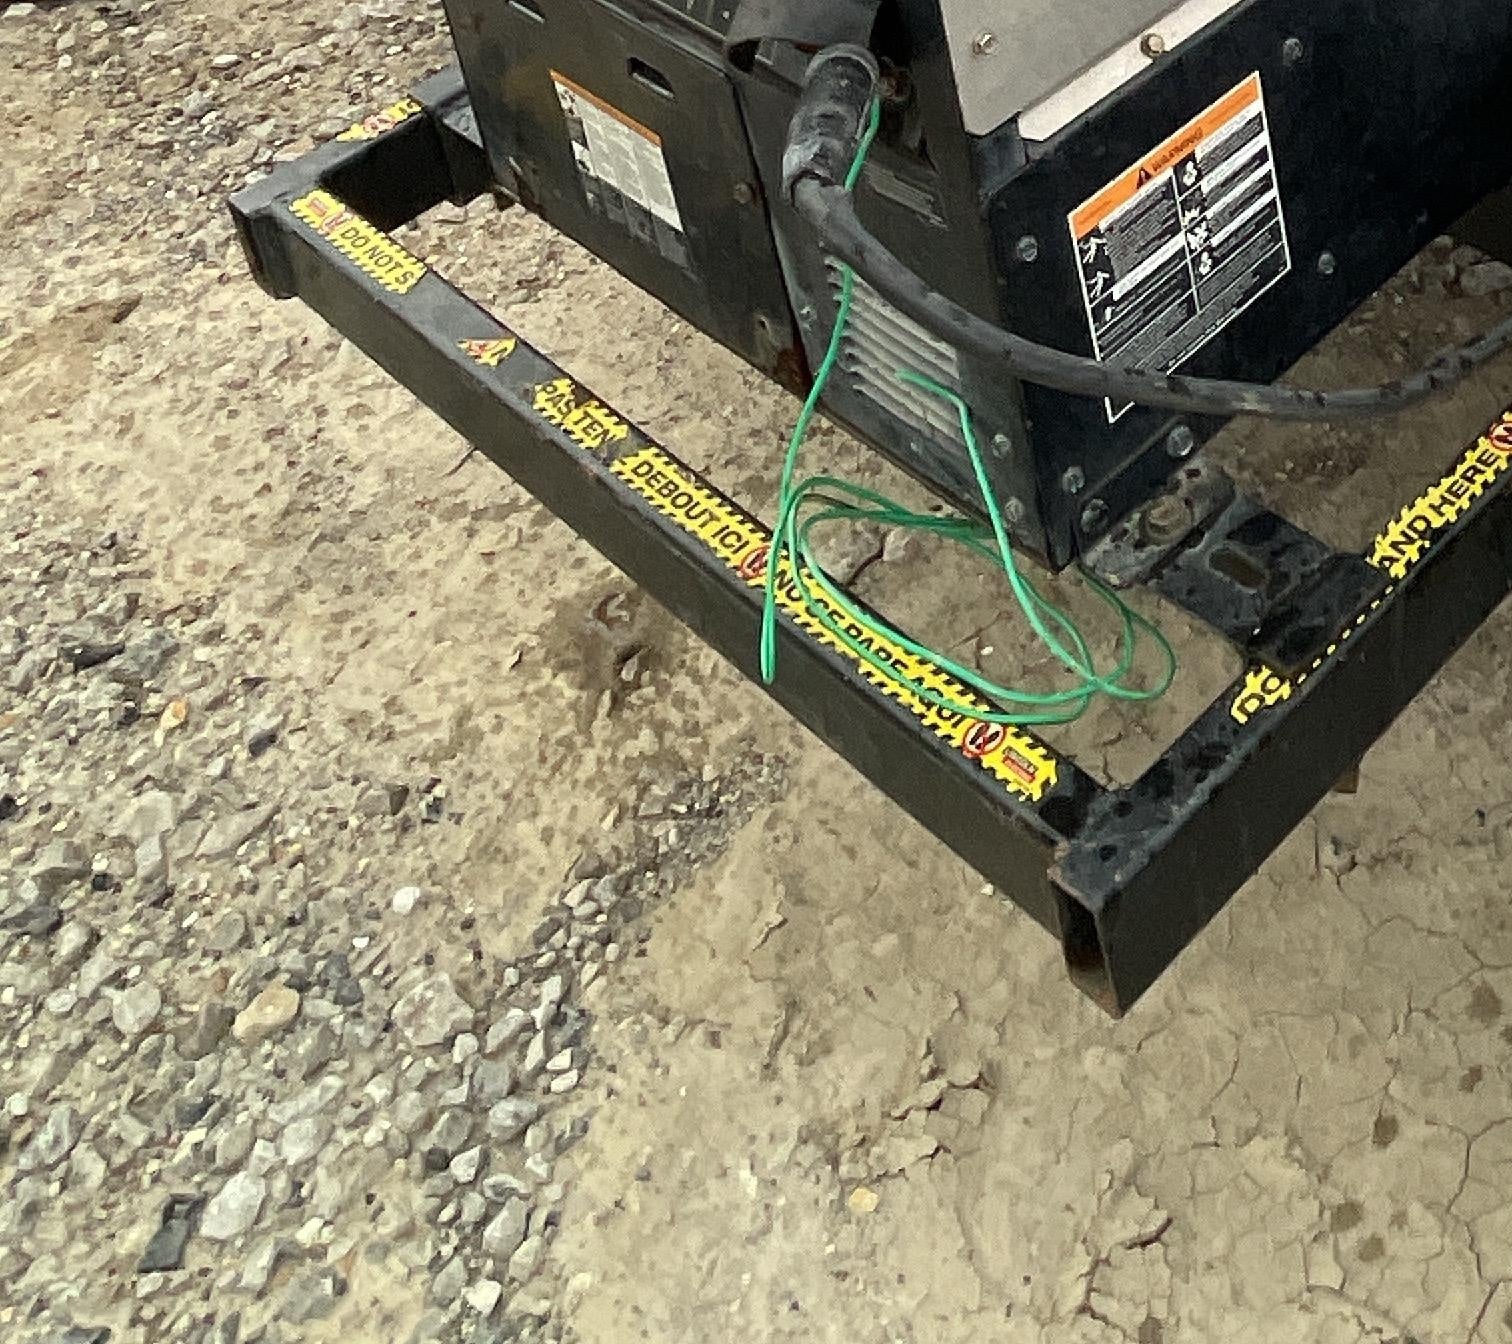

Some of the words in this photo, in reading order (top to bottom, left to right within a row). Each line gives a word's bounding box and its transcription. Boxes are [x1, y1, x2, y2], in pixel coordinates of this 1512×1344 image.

[340, 225, 368, 249] DO
[364, 244, 404, 275] NOT
[630, 460, 722, 530] DEBOUT
[711, 524, 750, 555] ICI
[1428, 448, 1500, 518] HERE
